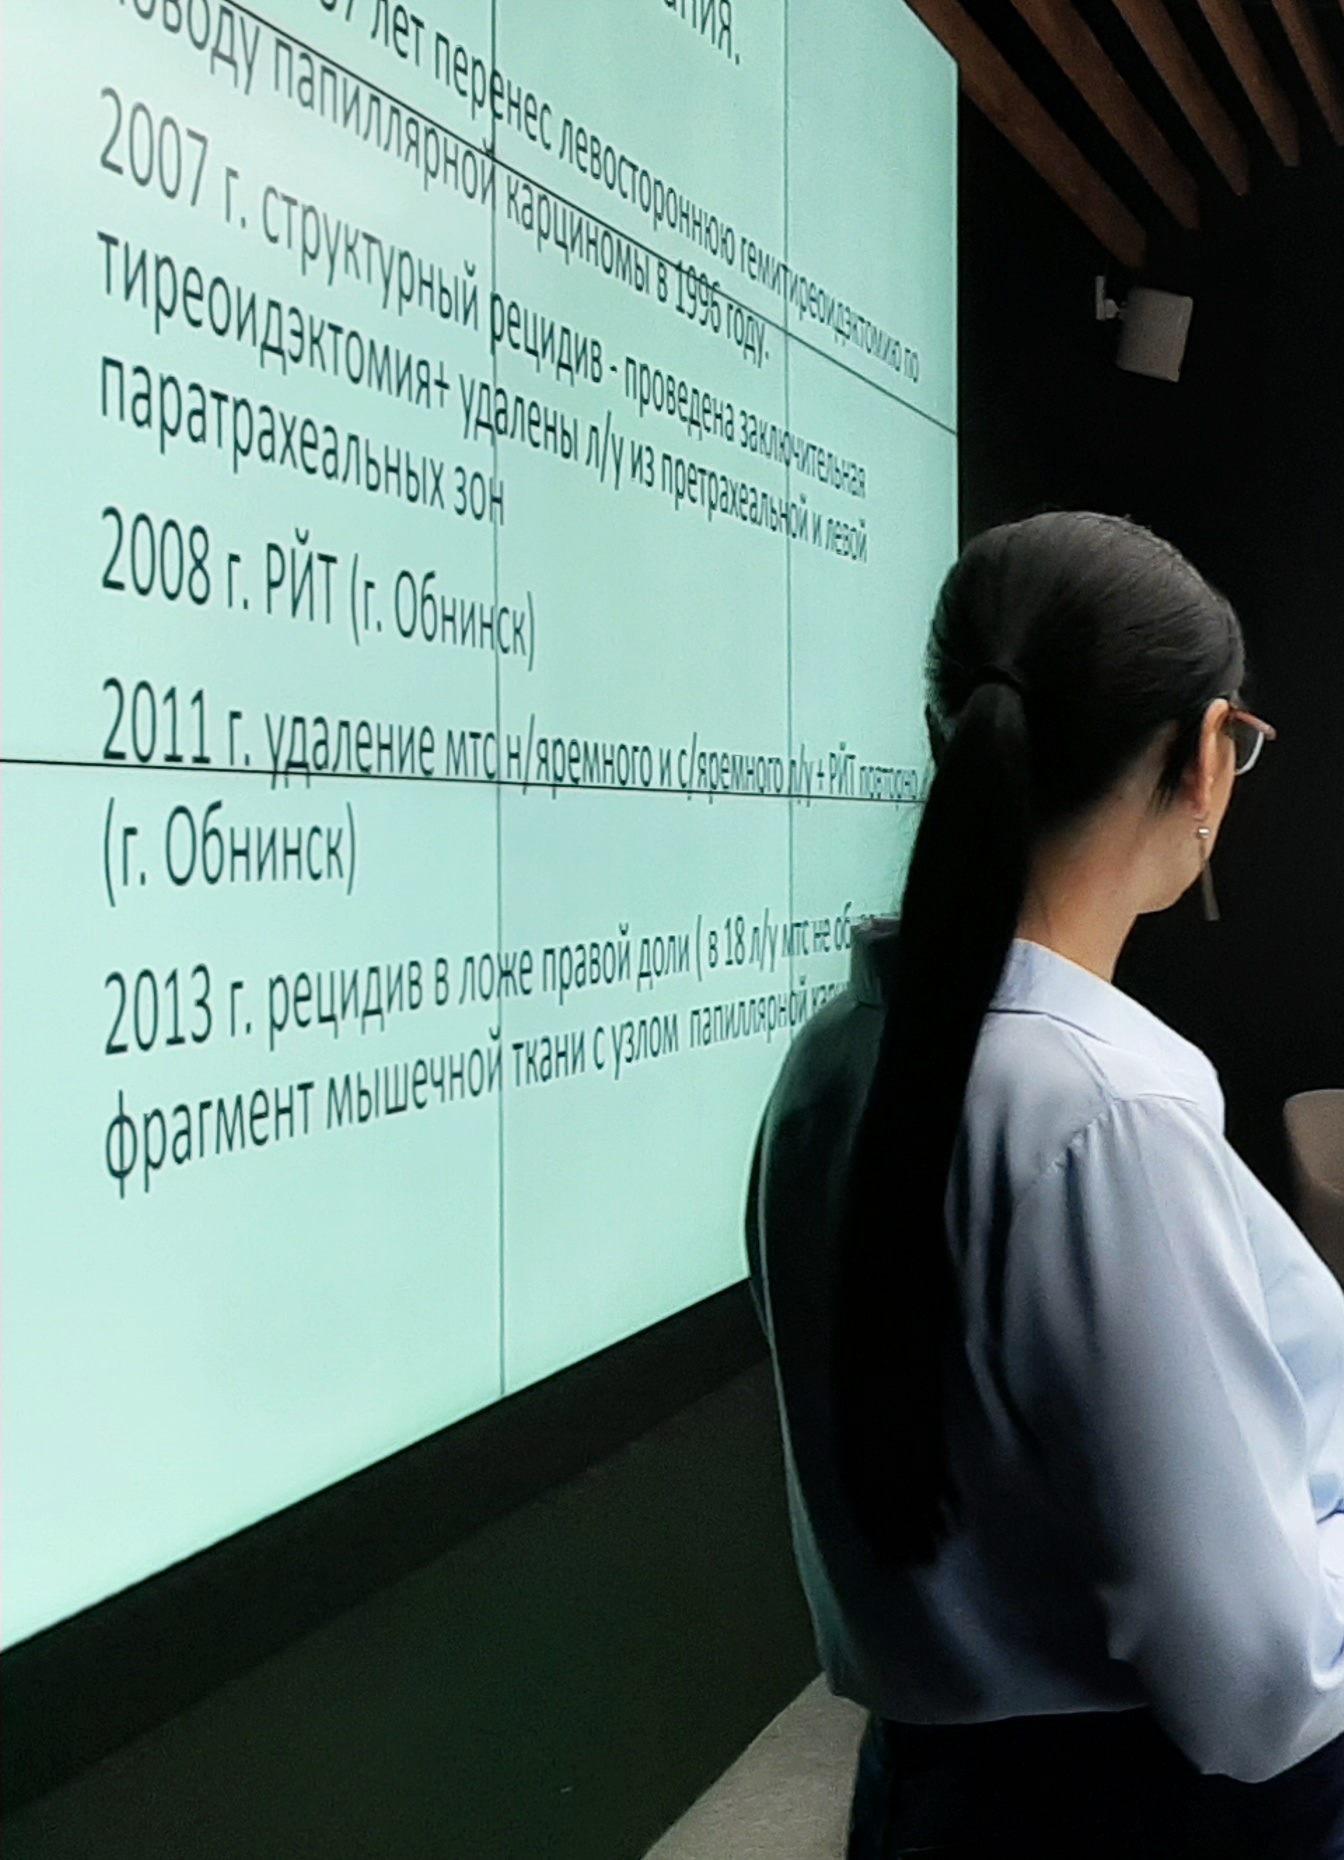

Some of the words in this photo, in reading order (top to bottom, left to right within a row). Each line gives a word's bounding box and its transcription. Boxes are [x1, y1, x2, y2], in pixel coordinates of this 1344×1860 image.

[275, 38, 496, 210] папиллярной
[506, 174, 650, 294] карциномы
[657, 261, 668, 303] в
[676, 260, 721, 333] 1996
[727, 303, 769, 368] году.
[371, 0, 424, 66] лет
[435, 31, 552, 151] перенес
[559, 118, 735, 266] левостороннюю
[100, 87, 209, 206] 2007
[224, 165, 247, 229] г.
[262, 184, 479, 331] структурный
[490, 291, 603, 387] рецидив
[626, 356, 734, 442] проведена
[740, 409, 867, 499] заключительная
[97, 230, 450, 408] тиреоидэктомия+
[459, 373, 578, 461] удалены
[585, 410, 624, 491] л/у
[631, 440, 655, 488] из
[662, 453, 808, 542] претрахеальной
[812, 511, 822, 547] и
[825, 518, 867, 564] левой
[101, 355, 445, 510] паратрахеальных
[454, 466, 504, 526] зон
[102, 506, 211, 605] 2008
[227, 553, 249, 609] г.
[267, 527, 338, 624] РЙТ
[351, 552, 382, 646] (г.
[394, 570, 535, 672] Обнинск)
[102, 677, 211, 764] 2011
[229, 710, 250, 766] г.
[265, 712, 434, 790] удаление
[446, 729, 496, 780] мтс
[507, 713, 652, 799] н/яремного
[659, 748, 671, 787] и
[678, 732, 783, 804] с/яремного
[829, 742, 856, 795] РЙТ
[104, 797, 146, 907] (г.
[165, 800, 356, 895] Обнинск)
[105, 963, 212, 1055] 2013
[230, 980, 251, 1037] г.
[269, 960, 423, 1051] рецидив
[434, 957, 449, 1006] в
[459, 949, 533, 1005] ложе
[542, 922, 631, 1006] правой
[637, 934, 690, 992] доли
[708, 930, 718, 968] в
[724, 915, 746, 966] 18
[750, 908, 778, 972] л/у
[106, 1081, 314, 1199] фрагмент
[327, 1025, 502, 1129] мышечной
[512, 1029, 585, 1087] ткани
[593, 1026, 604, 1069] с
[611, 1013, 679, 1081] узлом
[690, 974, 809, 1047] папиллярной
